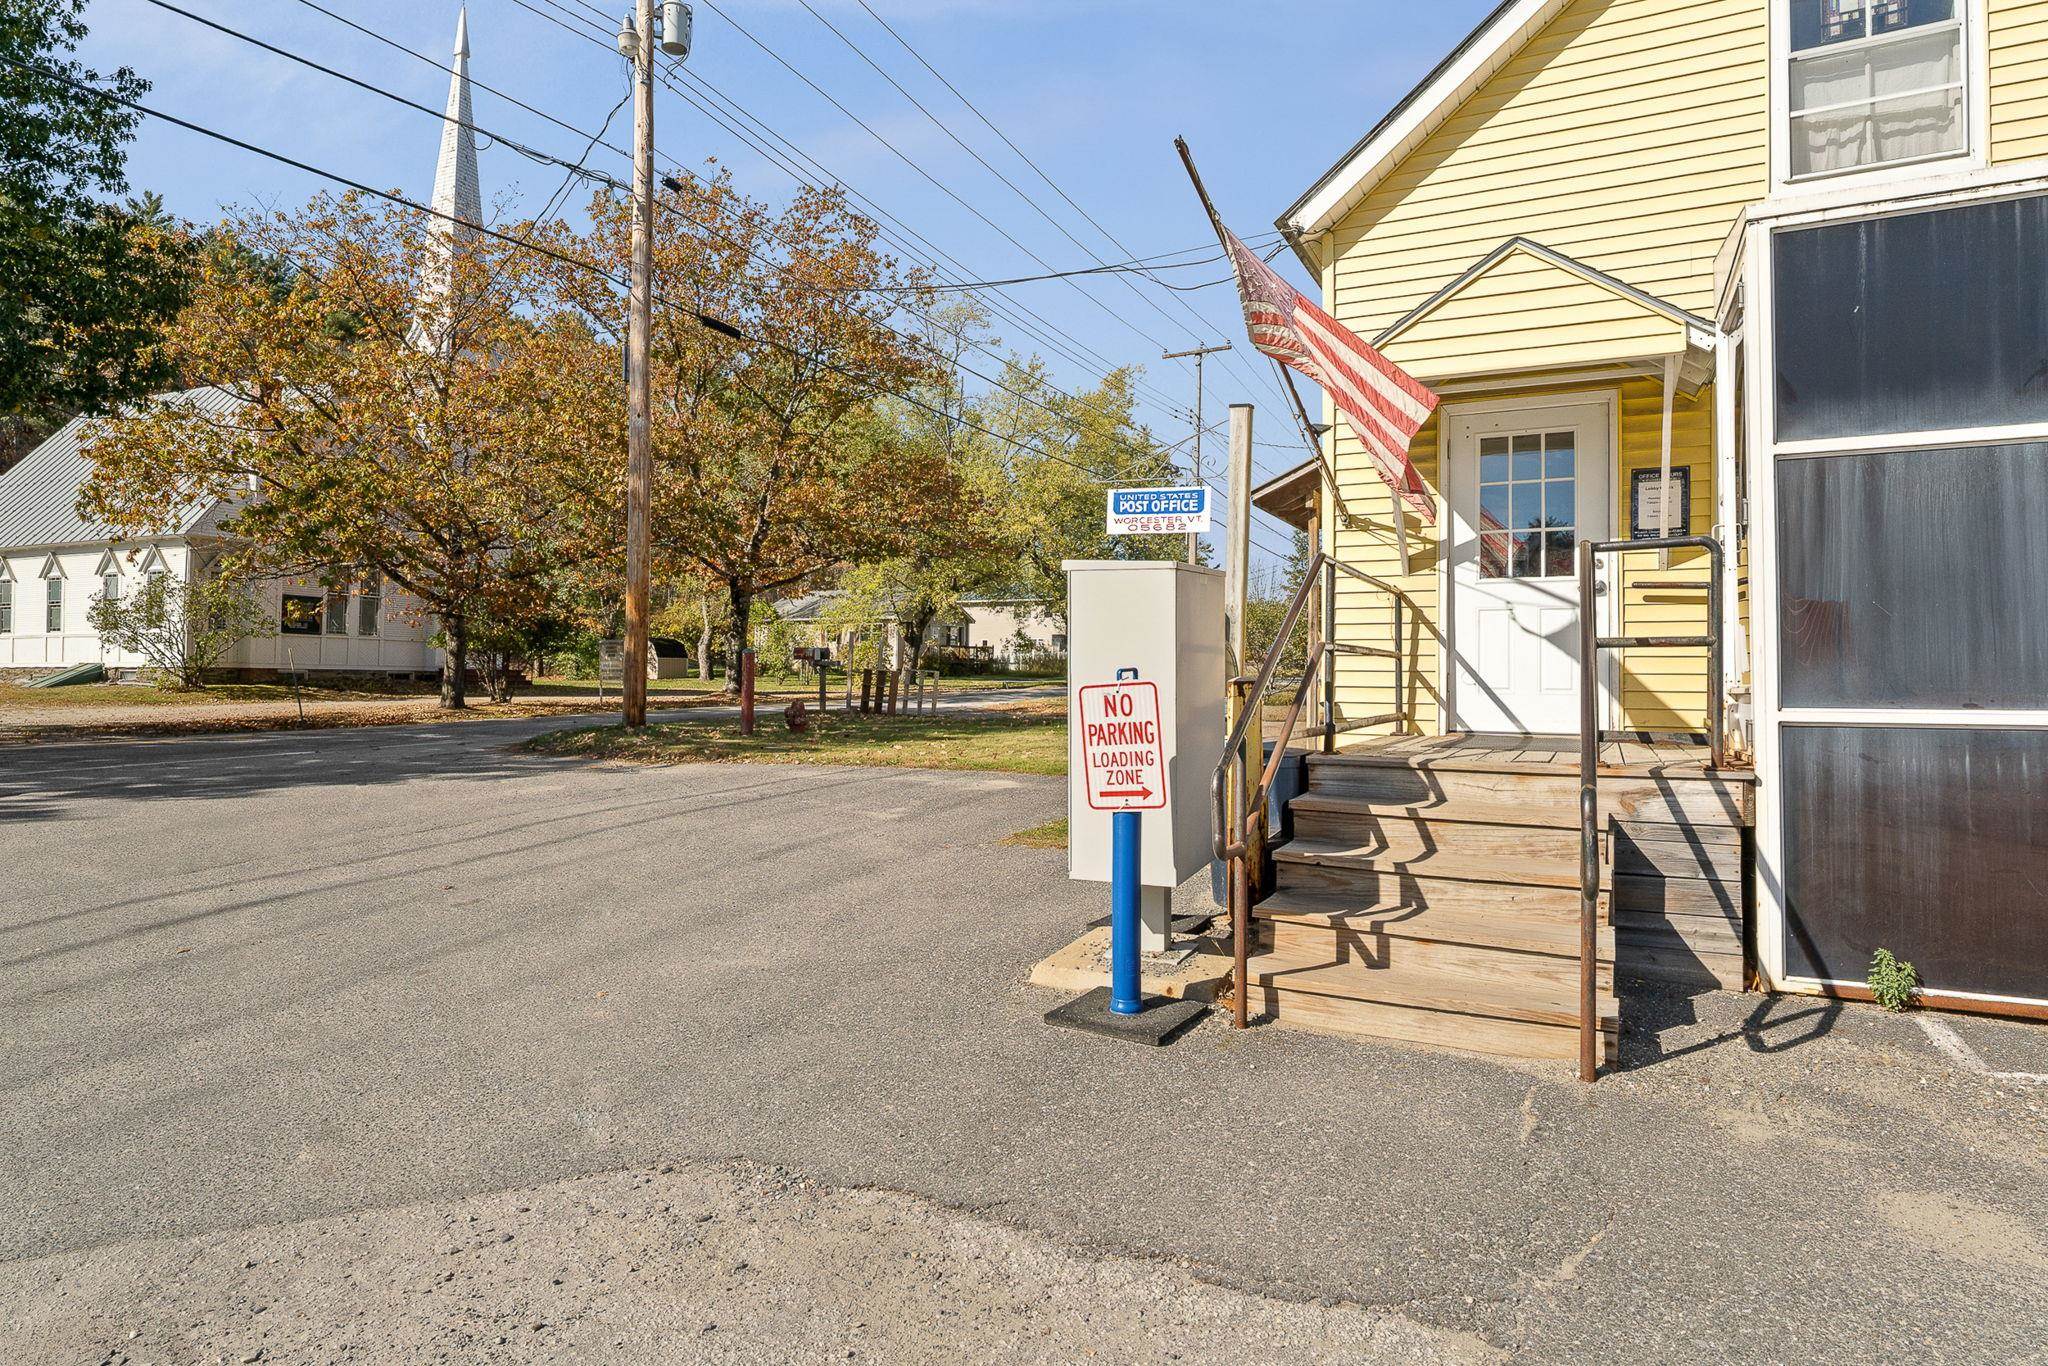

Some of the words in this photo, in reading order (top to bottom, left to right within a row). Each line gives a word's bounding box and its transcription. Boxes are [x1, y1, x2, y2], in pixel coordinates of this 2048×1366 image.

[1159, 492, 1199, 500] STATES
[1119, 500, 1148, 513] POST
[1151, 499, 1198, 512] OFFICE
[1114, 516, 1183, 524] WORCESTER
[1127, 523, 1187, 532] 05682
[1103, 693, 1133, 718] NO
[1088, 720, 1155, 747] PARKING
[1092, 750, 1154, 768] LOADING
[1106, 769, 1144, 786] ZONE
